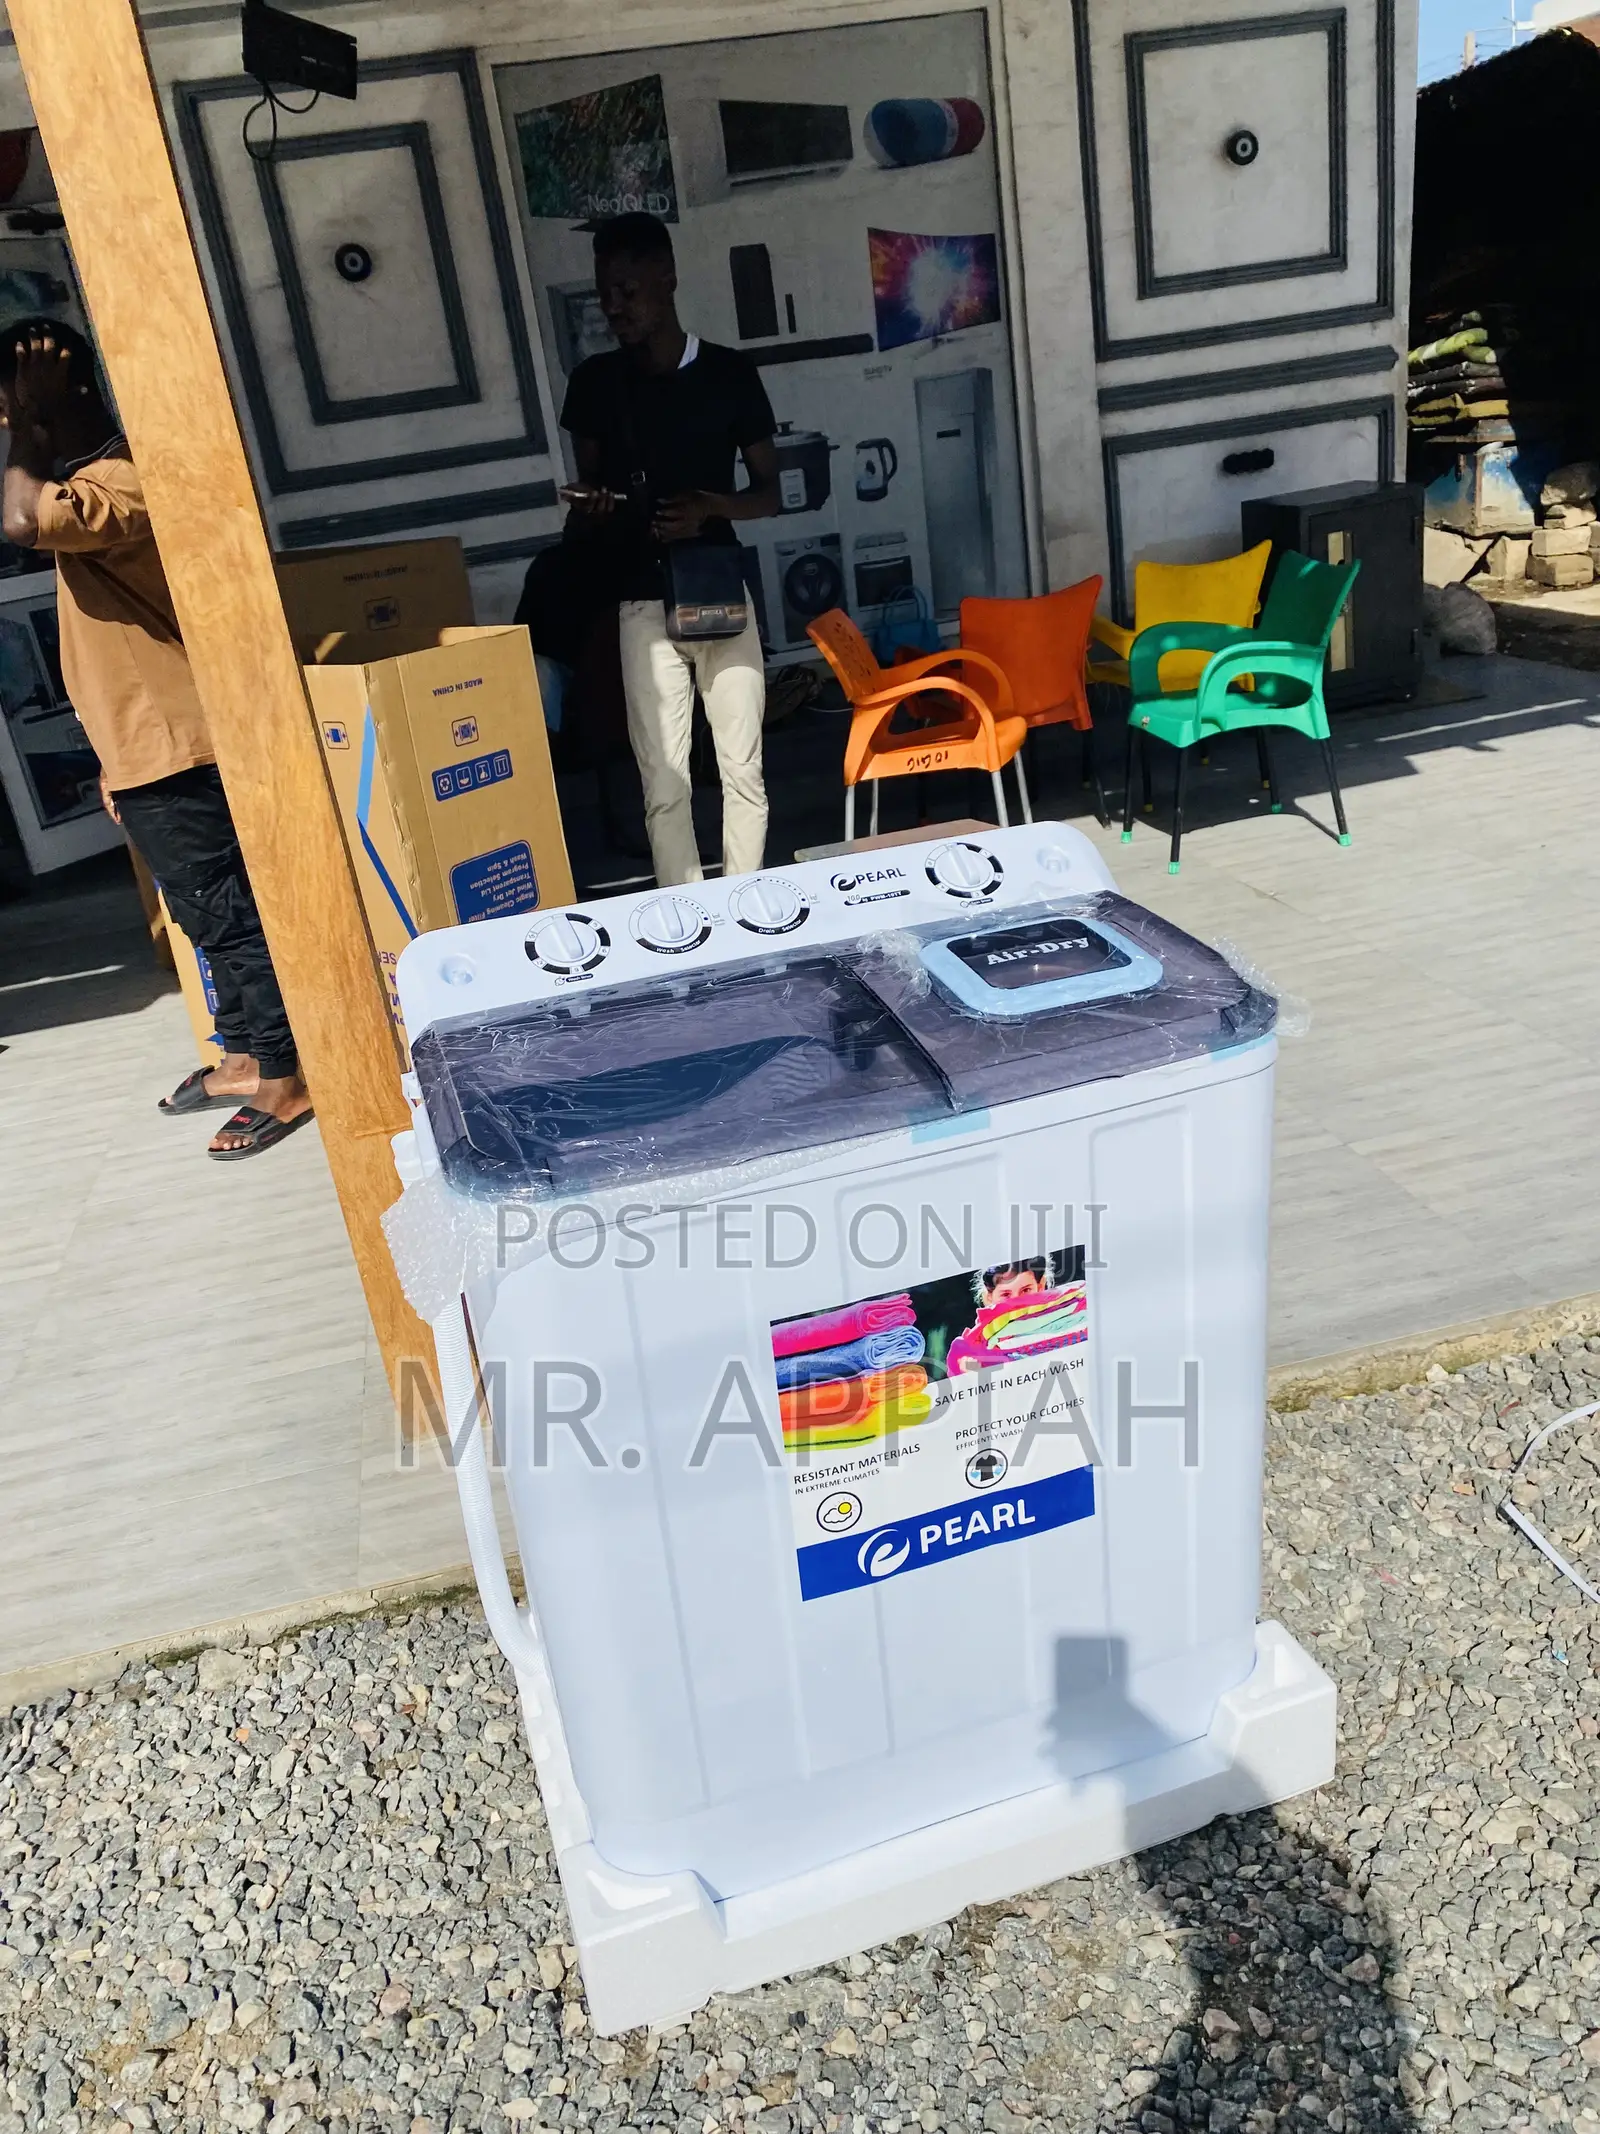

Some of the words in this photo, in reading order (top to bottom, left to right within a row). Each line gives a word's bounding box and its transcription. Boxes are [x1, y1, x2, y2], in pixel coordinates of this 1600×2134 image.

[455, 683, 463, 692] IN
[464, 677, 483, 689] MADE
[432, 685, 454, 697] CHINA
[510, 852, 527, 864] Wash
[487, 862, 502, 872] Spin
[502, 862, 529, 877] Program
[470, 873, 501, 889] Selection
[492, 872, 531, 891] Transparent
[855, 868, 906, 885] PEARL
[481, 888, 492, 897] Lid
[505, 888, 515, 896] Jet
[517, 882, 533, 893] Wind
[493, 893, 504, 902] Dry
[515, 891, 535, 903] Magic
[486, 899, 515, 915] Cleaning
[781, 919, 802, 932] Selector
[986, 937, 1090, 966] Air-Dry
[935, 1390, 965, 1407] SAVE
[967, 1381, 997, 1397] TIME
[1000, 1378, 1013, 1389] IN
[1017, 1369, 1047, 1385] EACH
[1050, 1358, 1085, 1376] WASH
[955, 1419, 1003, 1440] PROTECT
[1006, 1411, 1037, 1426] YOUR
[1039, 1396, 1085, 1417] CLOTHES
[956, 1434, 999, 1451] EFFICIENTLY
[1000, 1428, 1024, 1439] WASH
[794, 1462, 856, 1484] RESISTANT
[858, 1443, 921, 1469] MATERIALS
[806, 1479, 841, 1493] EXTREME
[843, 1468, 880, 1484] CLIMATES
[919, 1499, 1036, 1554] PEARL
